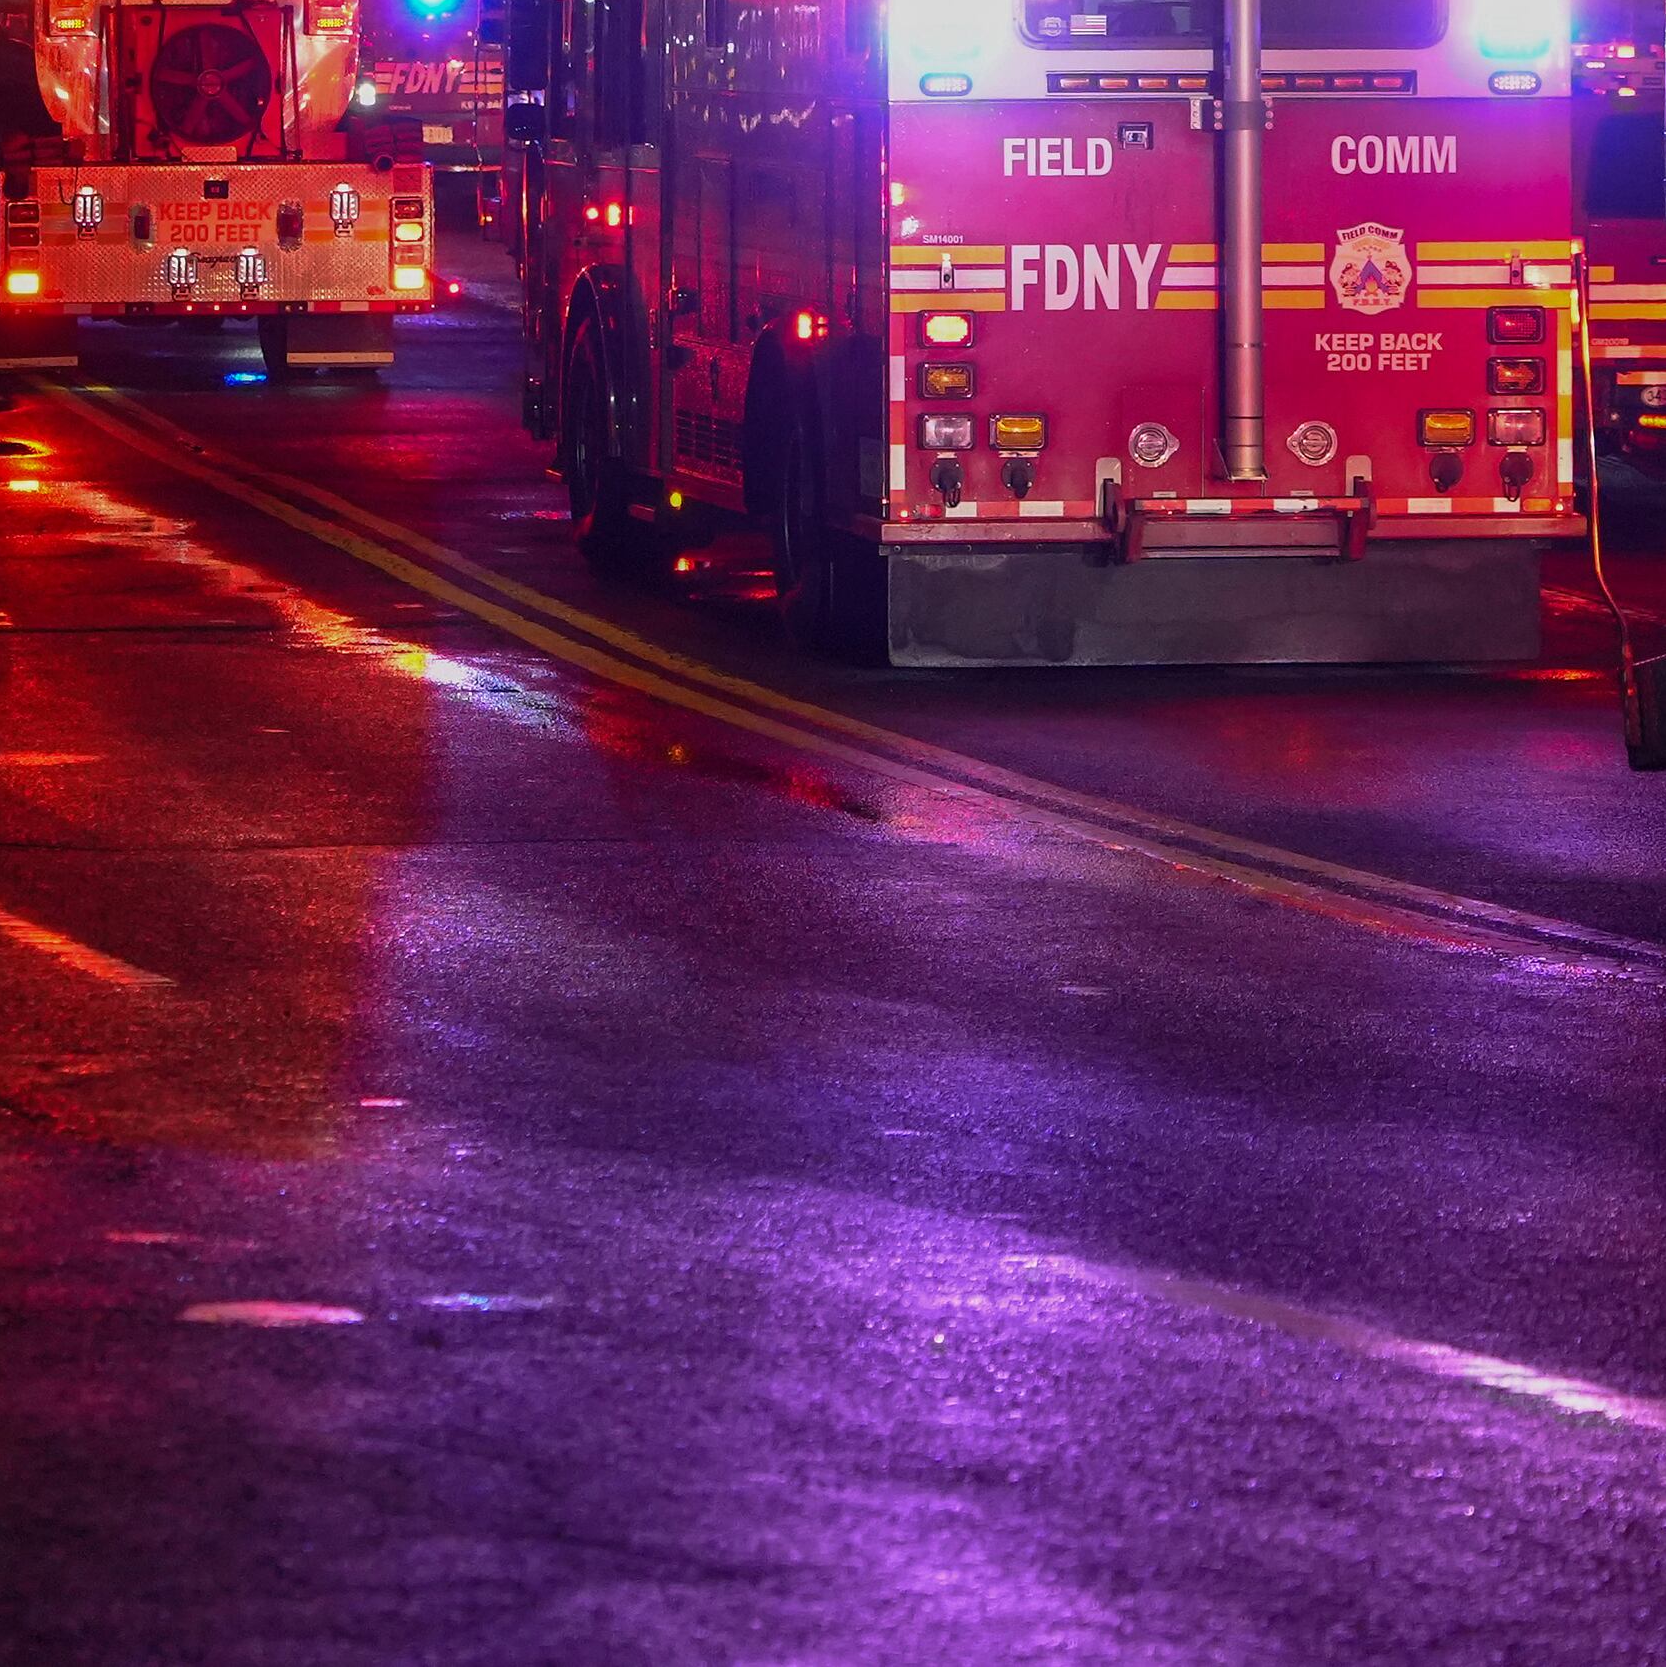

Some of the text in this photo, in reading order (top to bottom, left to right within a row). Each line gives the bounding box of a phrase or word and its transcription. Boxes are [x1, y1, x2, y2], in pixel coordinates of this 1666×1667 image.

[389, 60, 465, 94] FDNY
[1003, 135, 1457, 176] FIELD COMM
[158, 203, 272, 221] KEEP BACK
[170, 224, 261, 242] 200 FEET
[922, 235, 964, 244] SM14001
[1341, 225, 1398, 241] FIELD COMM
[1011, 244, 1162, 310] FDNY
[1314, 333, 1444, 351] KEEP BACK
[1326, 353, 1433, 371] 200 FEET
